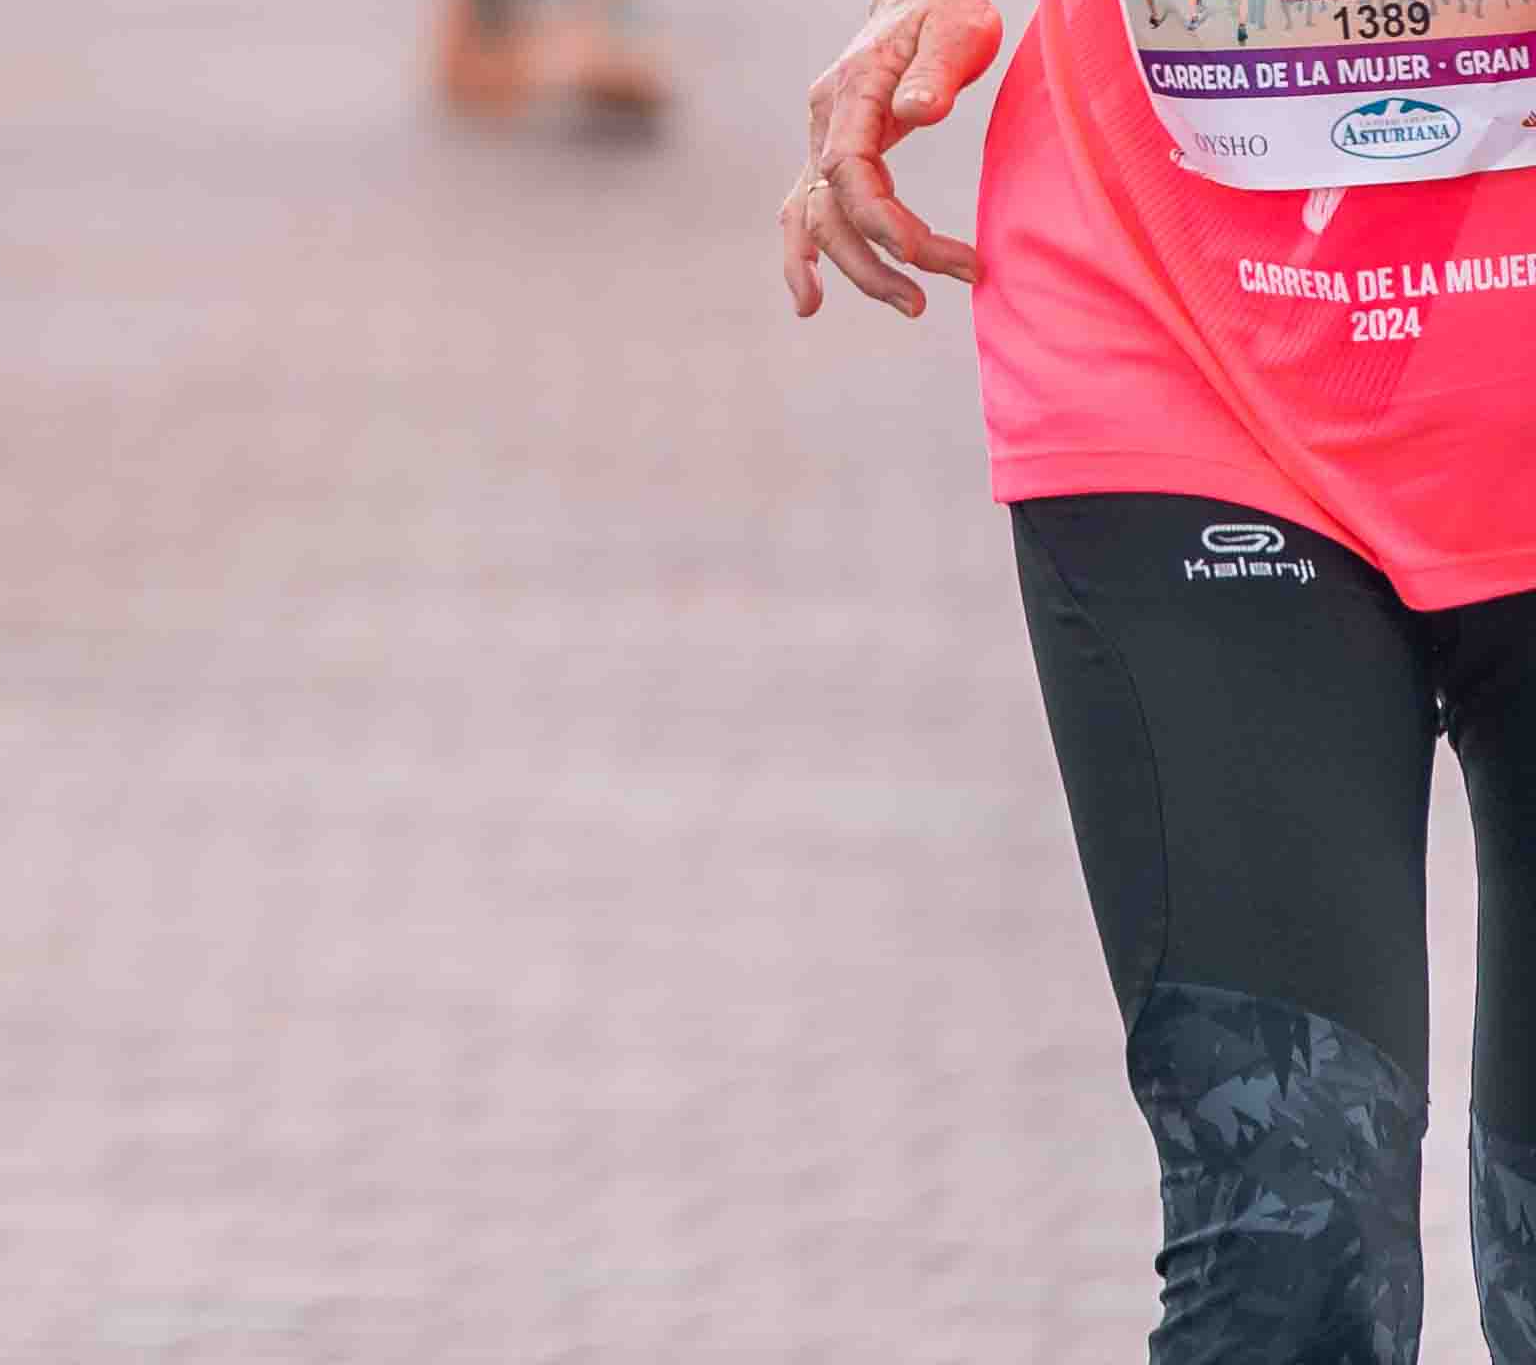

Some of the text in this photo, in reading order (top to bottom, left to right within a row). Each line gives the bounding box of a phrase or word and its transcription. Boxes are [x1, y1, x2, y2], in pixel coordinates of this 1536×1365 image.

[1333, 1, 1431, 40] 1389
[1152, 46, 1529, 91] CARRERA DE LA MUJER GRAN
[1343, 124, 1451, 145] ASTURIANA
[1238, 259, 1351, 303] CARRERA
[1358, 268, 1394, 302] DE
[1403, 263, 1438, 297] LA
[1352, 308, 1422, 341] 2024
